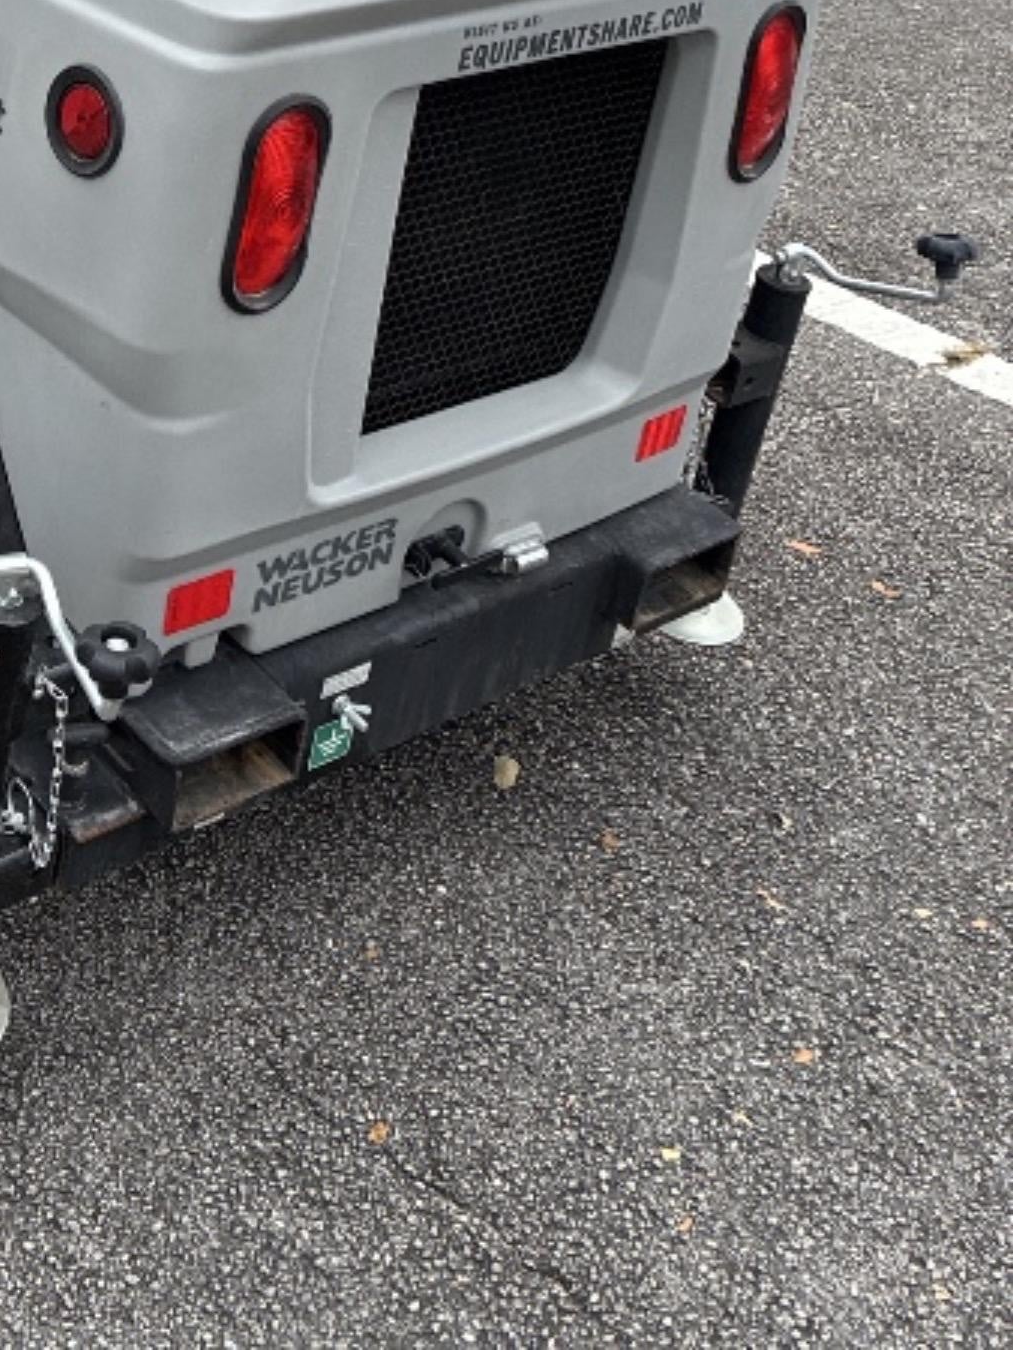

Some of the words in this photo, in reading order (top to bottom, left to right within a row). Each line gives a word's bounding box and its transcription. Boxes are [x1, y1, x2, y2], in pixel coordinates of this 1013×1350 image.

[458, 0, 704, 72] EQUIPMENTSHARE.COM
[251, 544, 393, 614] NEUSON
[256, 517, 399, 584] WACKER
